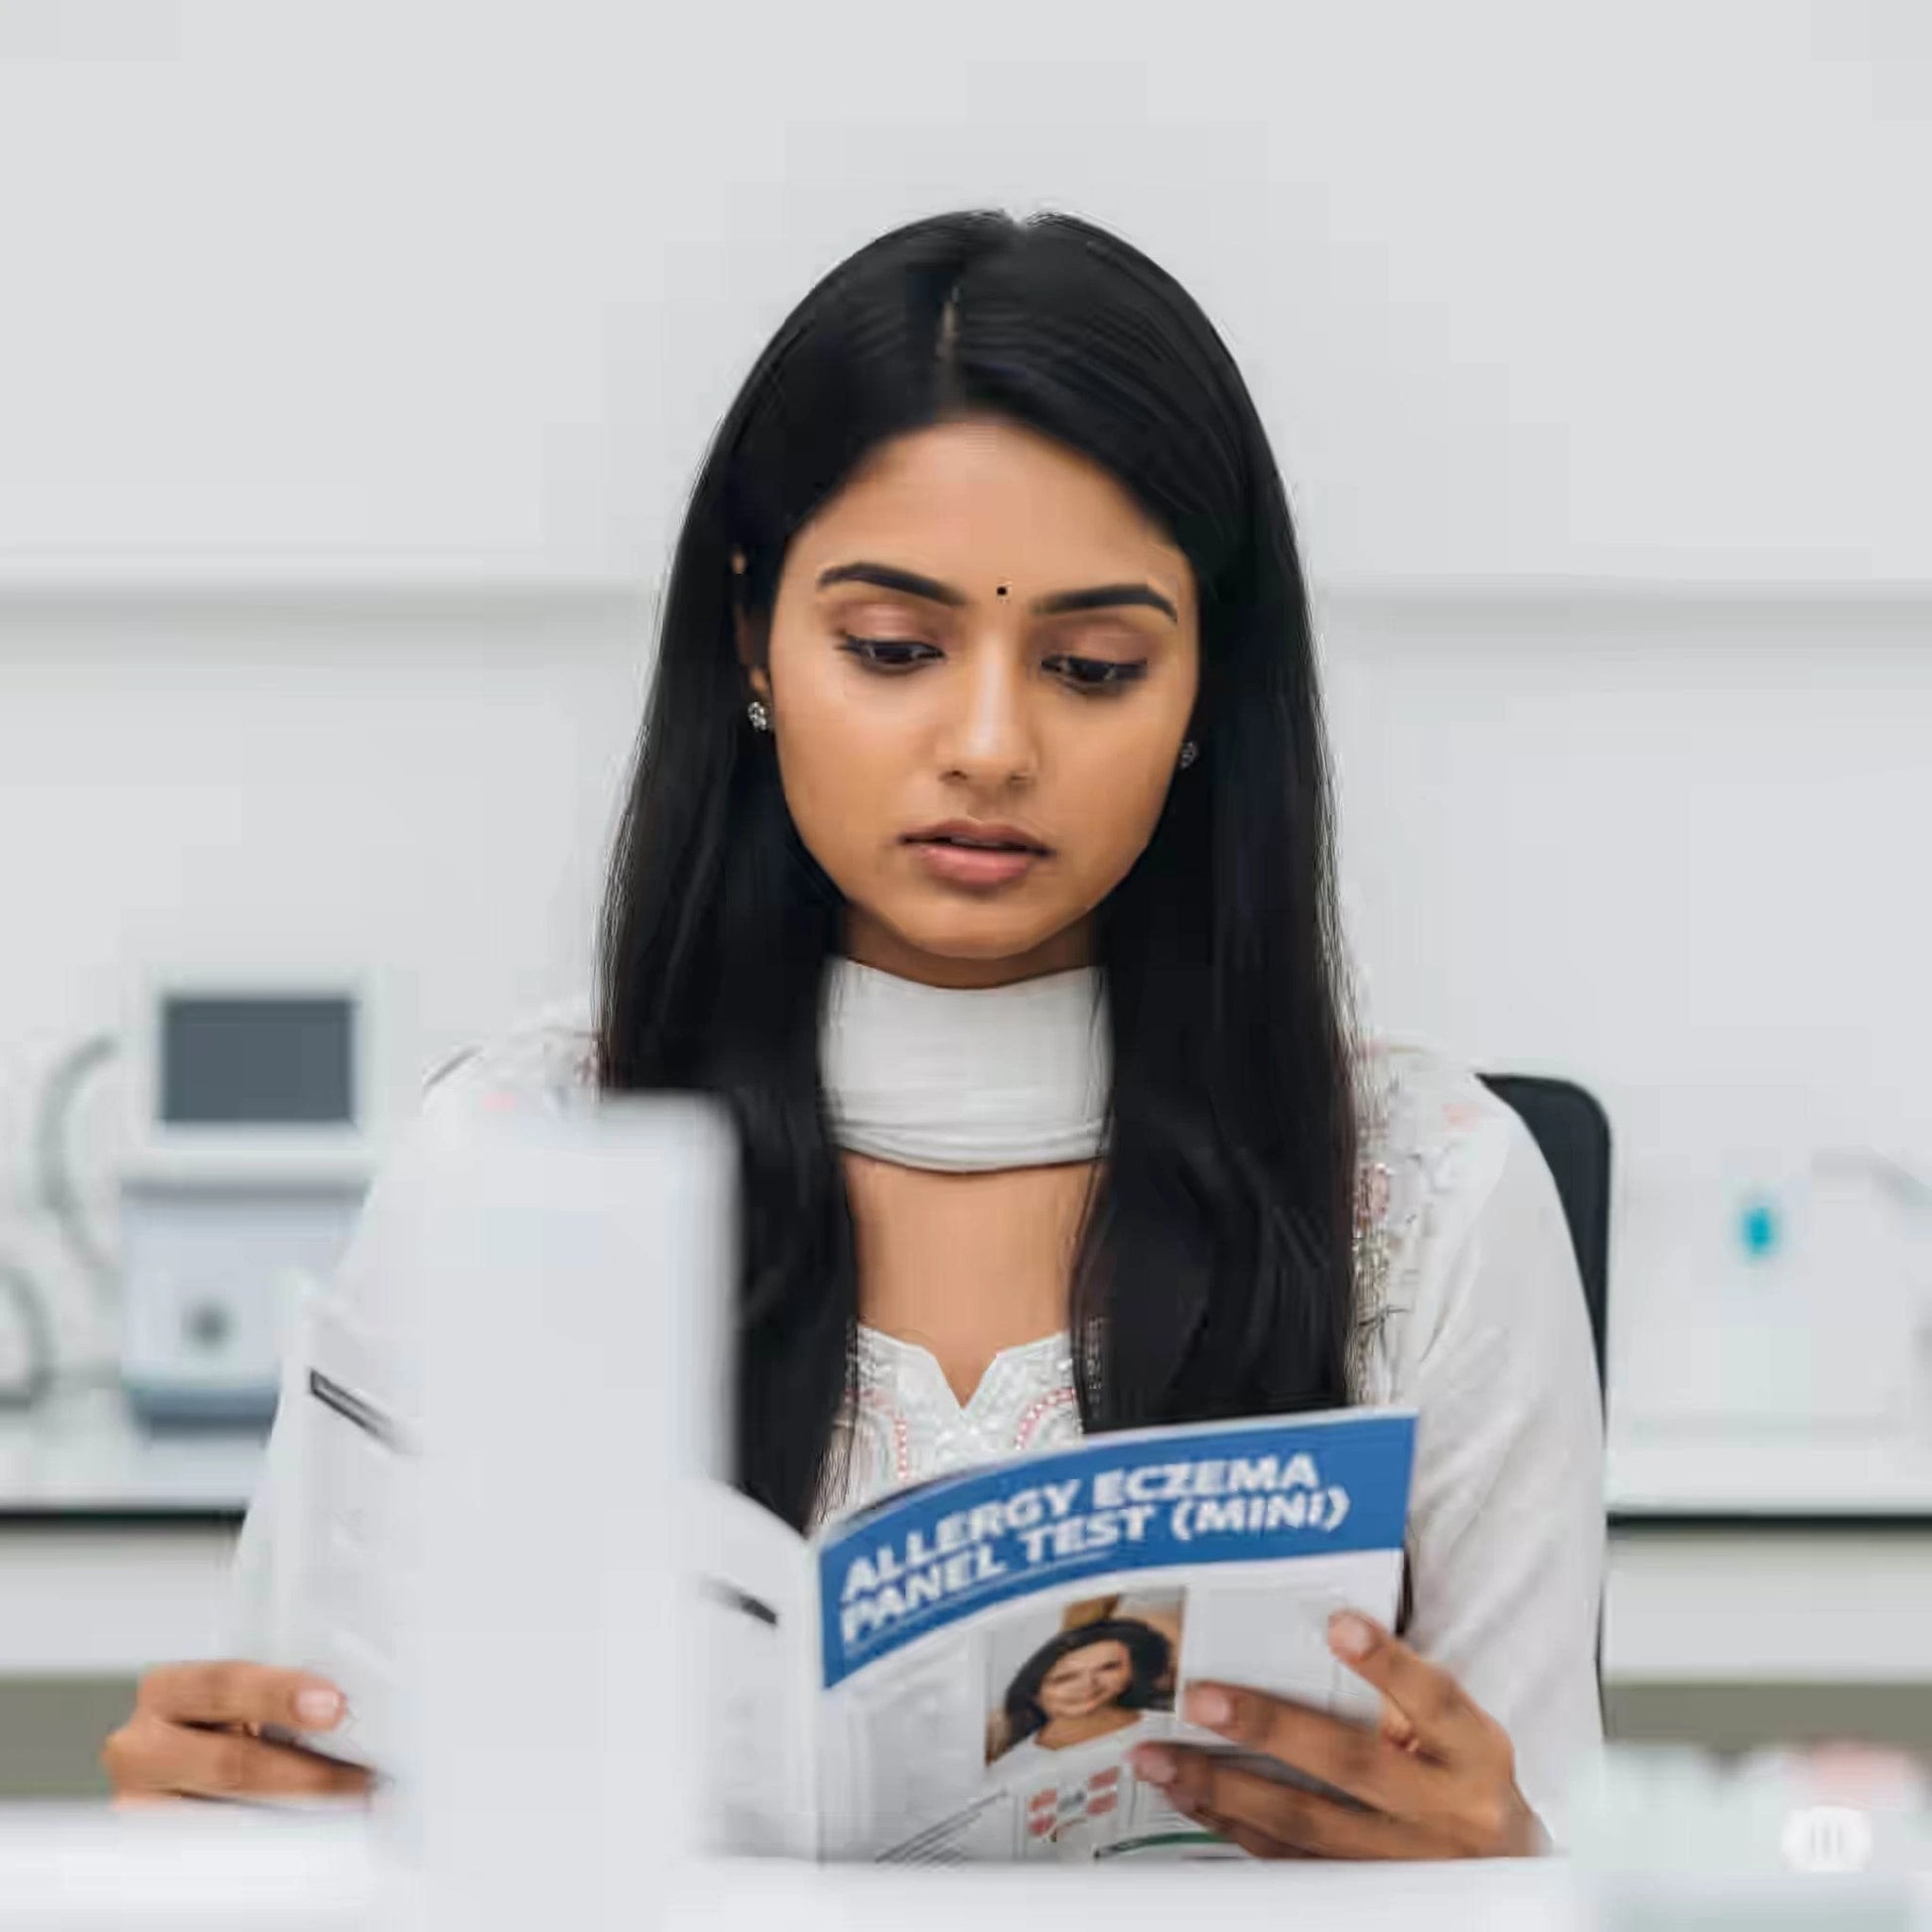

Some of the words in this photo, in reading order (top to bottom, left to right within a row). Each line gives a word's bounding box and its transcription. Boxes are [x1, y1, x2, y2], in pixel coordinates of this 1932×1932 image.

[842, 1478, 1081, 1599] ALLERGY
[1093, 1452, 1318, 1507] ECZEMA
[842, 1545, 1006, 1643] PANEL
[1022, 1506, 1155, 1564] TEST
[1172, 1485, 1350, 1541] (MINI)
